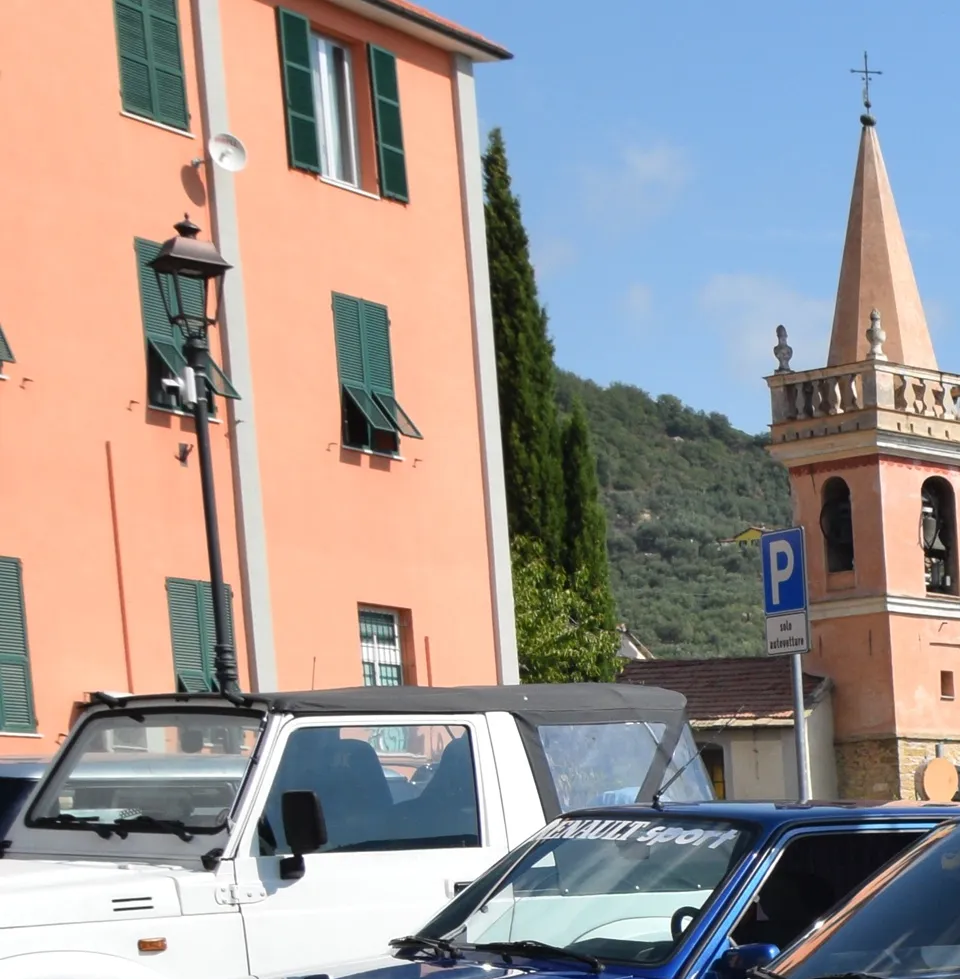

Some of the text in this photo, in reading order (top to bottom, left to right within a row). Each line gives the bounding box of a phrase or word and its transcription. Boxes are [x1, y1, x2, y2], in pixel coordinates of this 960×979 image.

[770, 540, 794, 605] P
[780, 620, 792, 632] solo
[770, 636, 804, 650] autovetture
